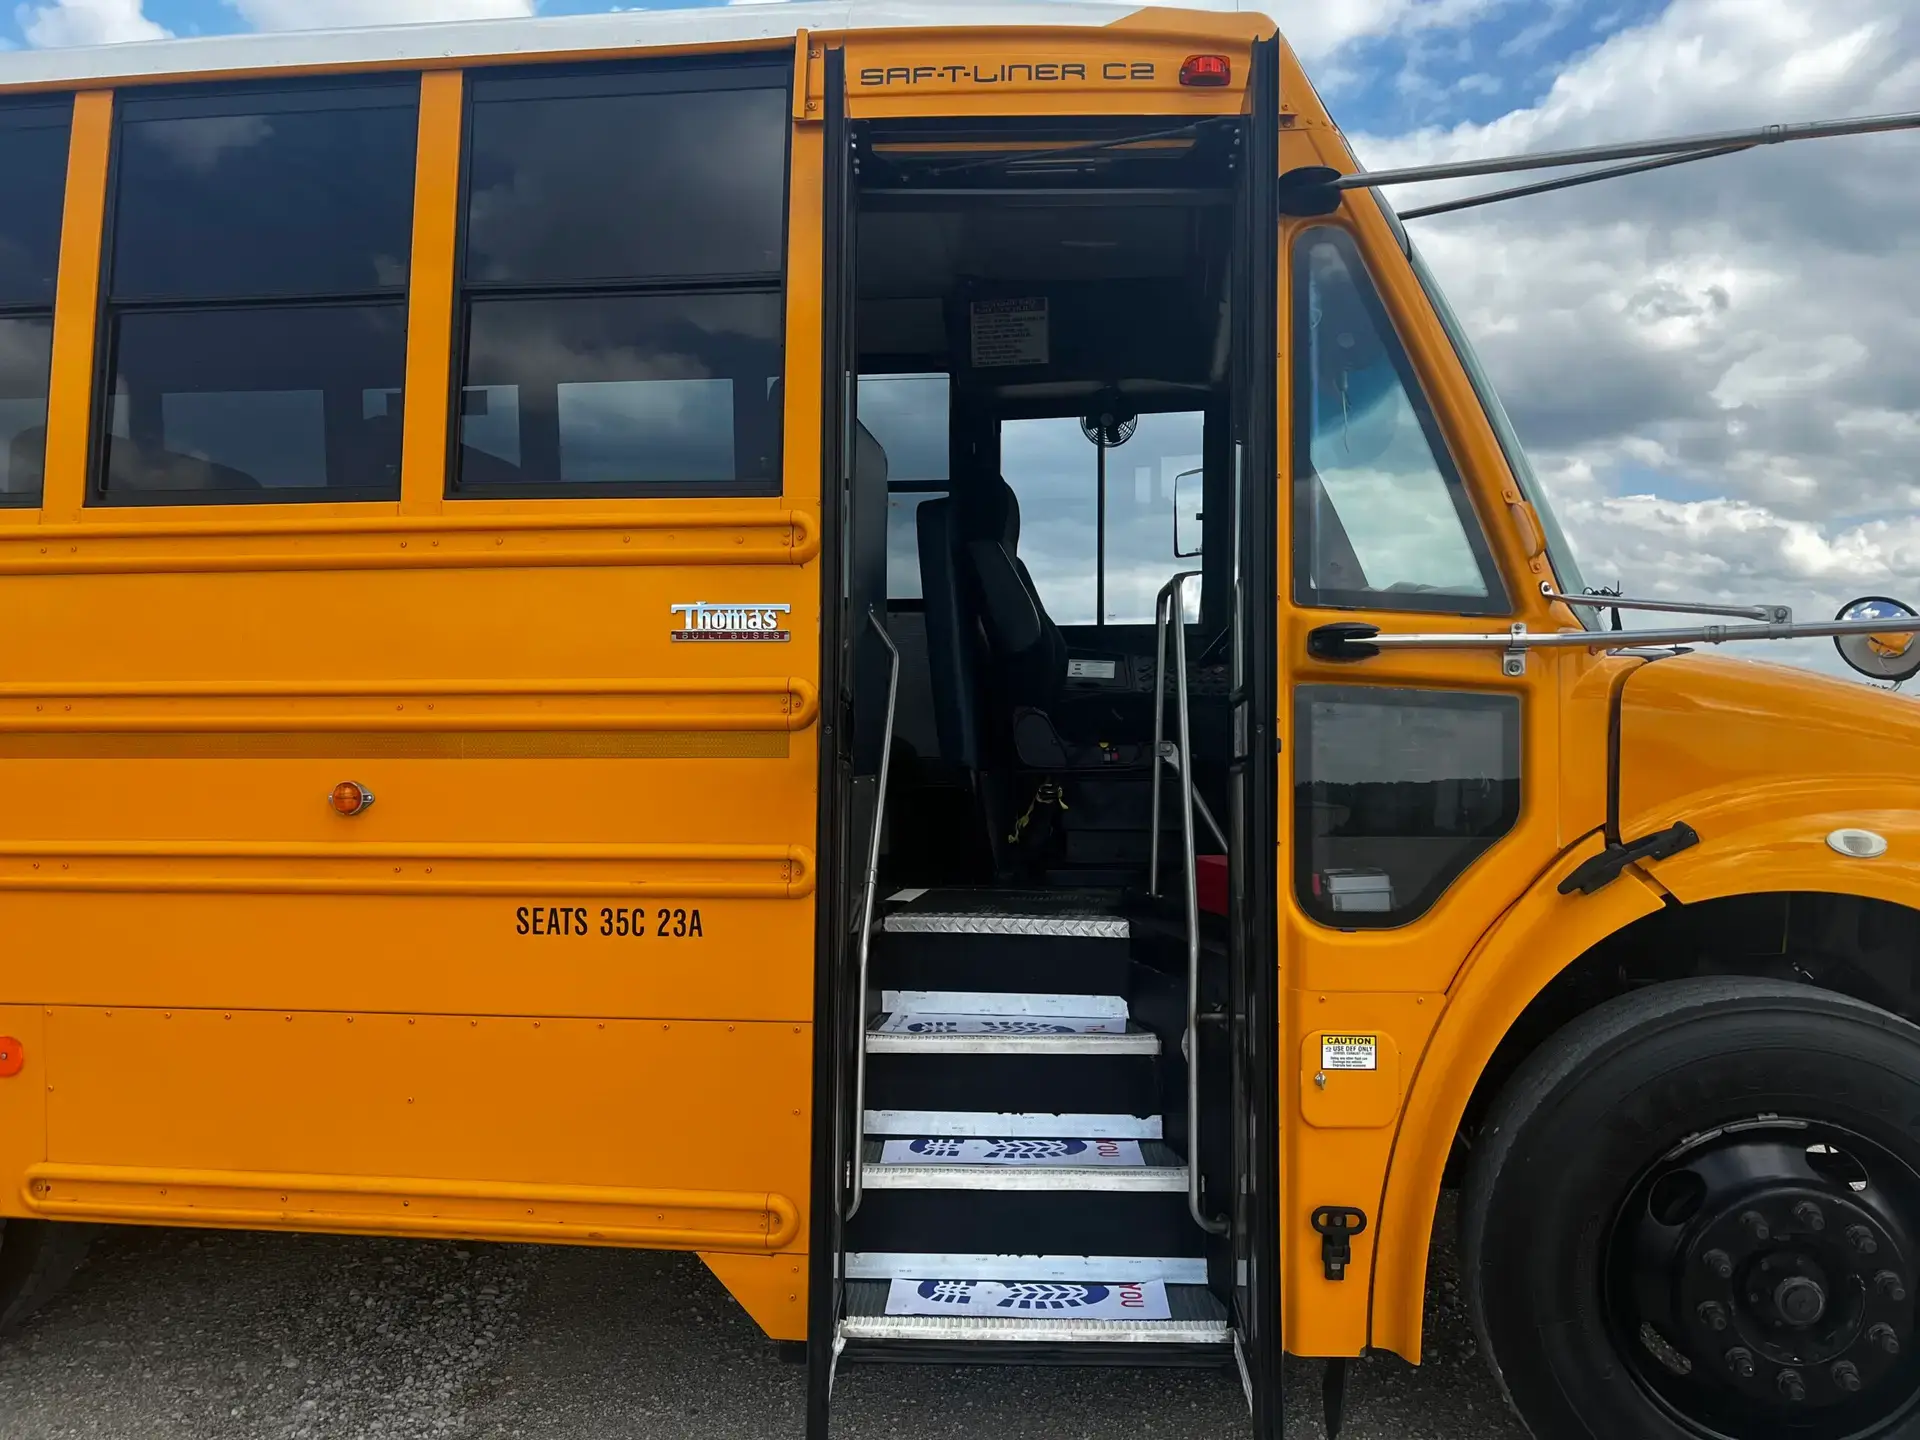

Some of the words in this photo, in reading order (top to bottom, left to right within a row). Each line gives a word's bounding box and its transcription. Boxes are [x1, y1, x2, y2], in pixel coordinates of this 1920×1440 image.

[860, 63, 1085, 86] SAF-T-LINER
[1102, 63, 1155, 81] C2
[671, 601, 790, 630] Thomas
[682, 632, 722, 640] BUILT
[731, 632, 780, 640] BUSES
[516, 906, 588, 936] SEATS
[600, 907, 644, 937] 35C
[657, 908, 703, 937] 23A
[1327, 1037, 1371, 1045] CAUTION
[1118, 1284, 1145, 1307] YOU
